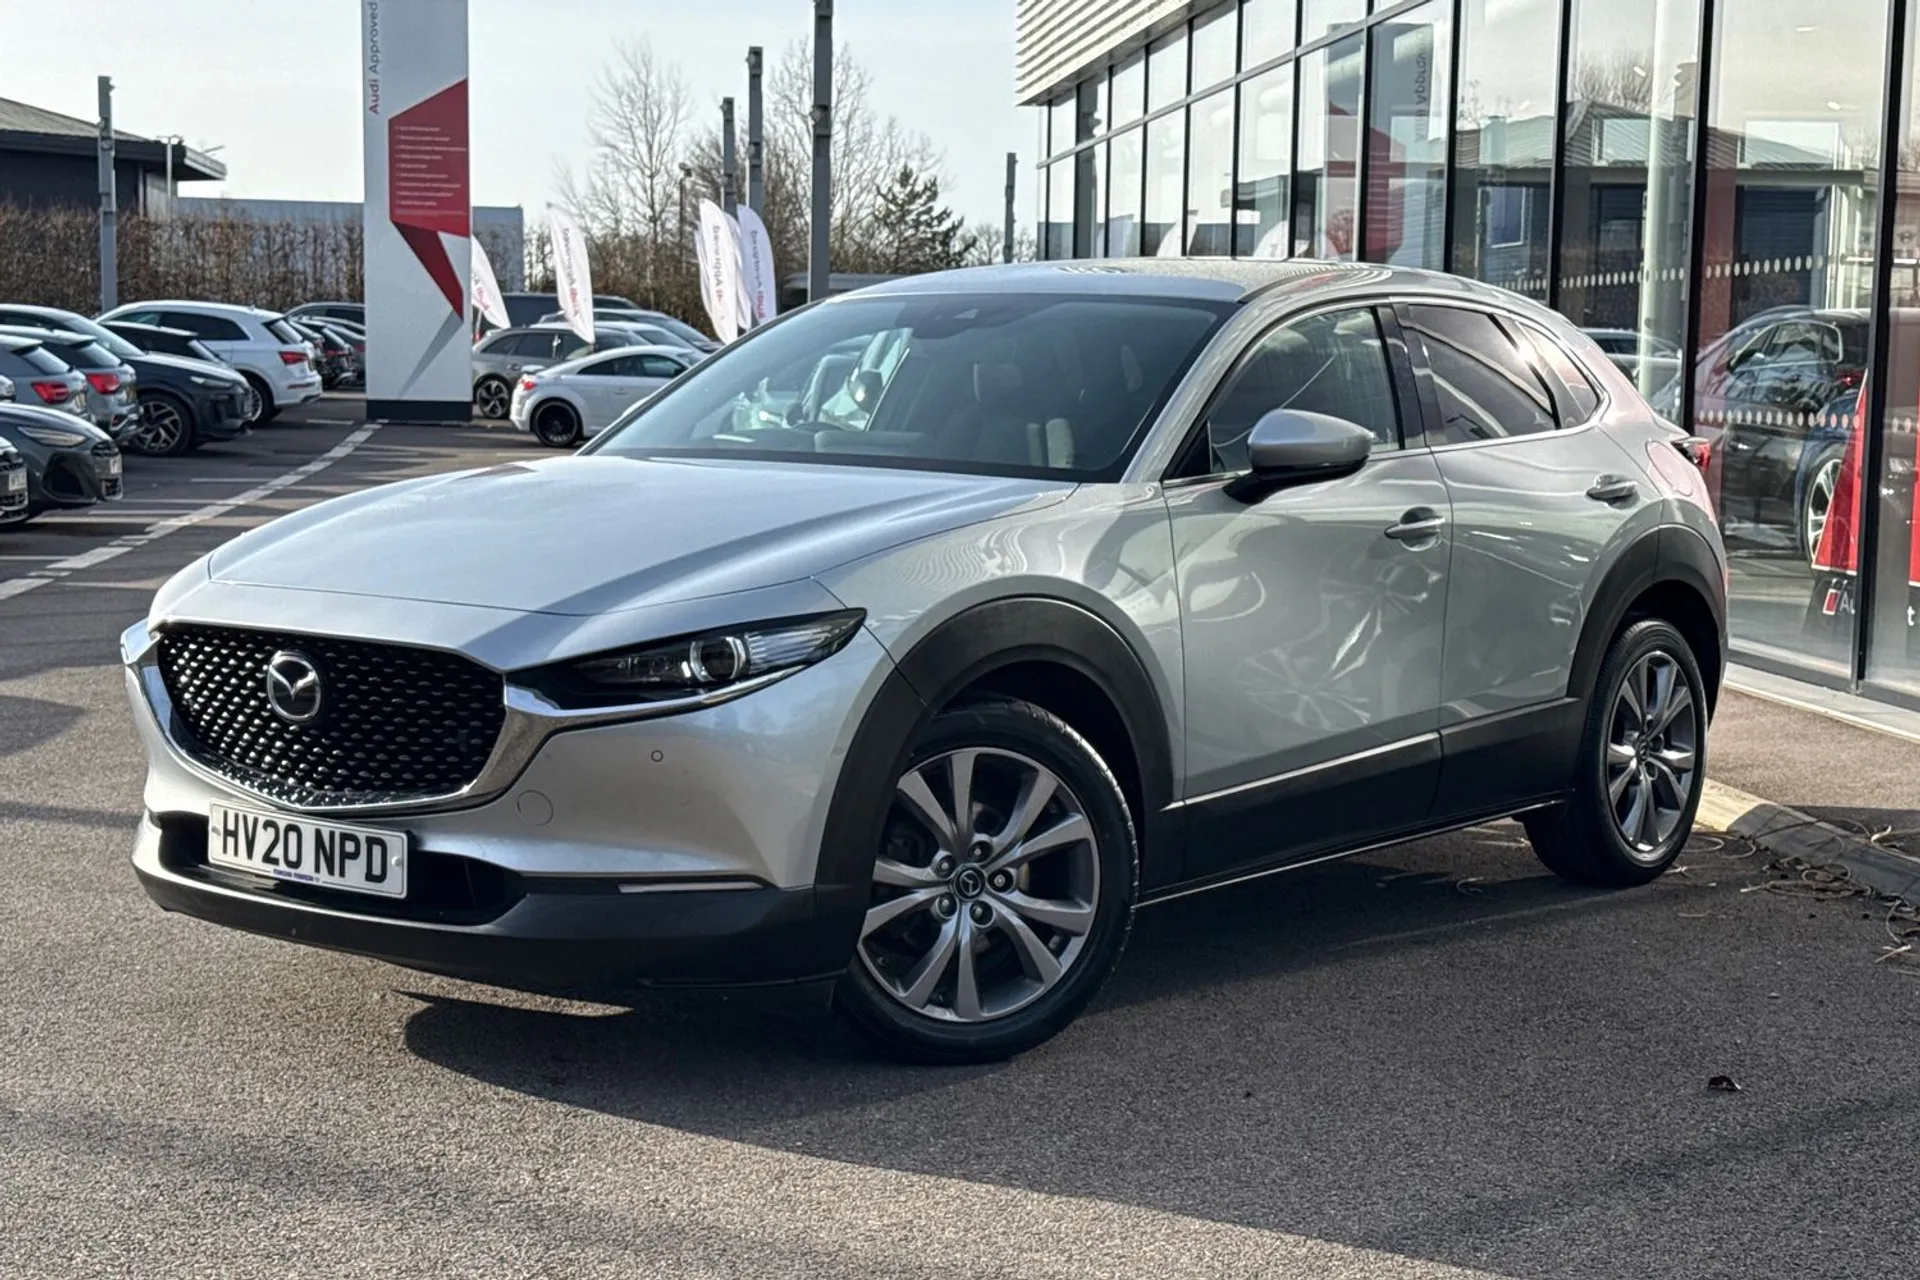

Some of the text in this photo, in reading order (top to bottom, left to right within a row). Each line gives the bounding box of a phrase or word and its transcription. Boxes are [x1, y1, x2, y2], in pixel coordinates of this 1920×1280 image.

[367, 1, 381, 115] Audi Approved
[222, 809, 388, 884] HV20 NPD
